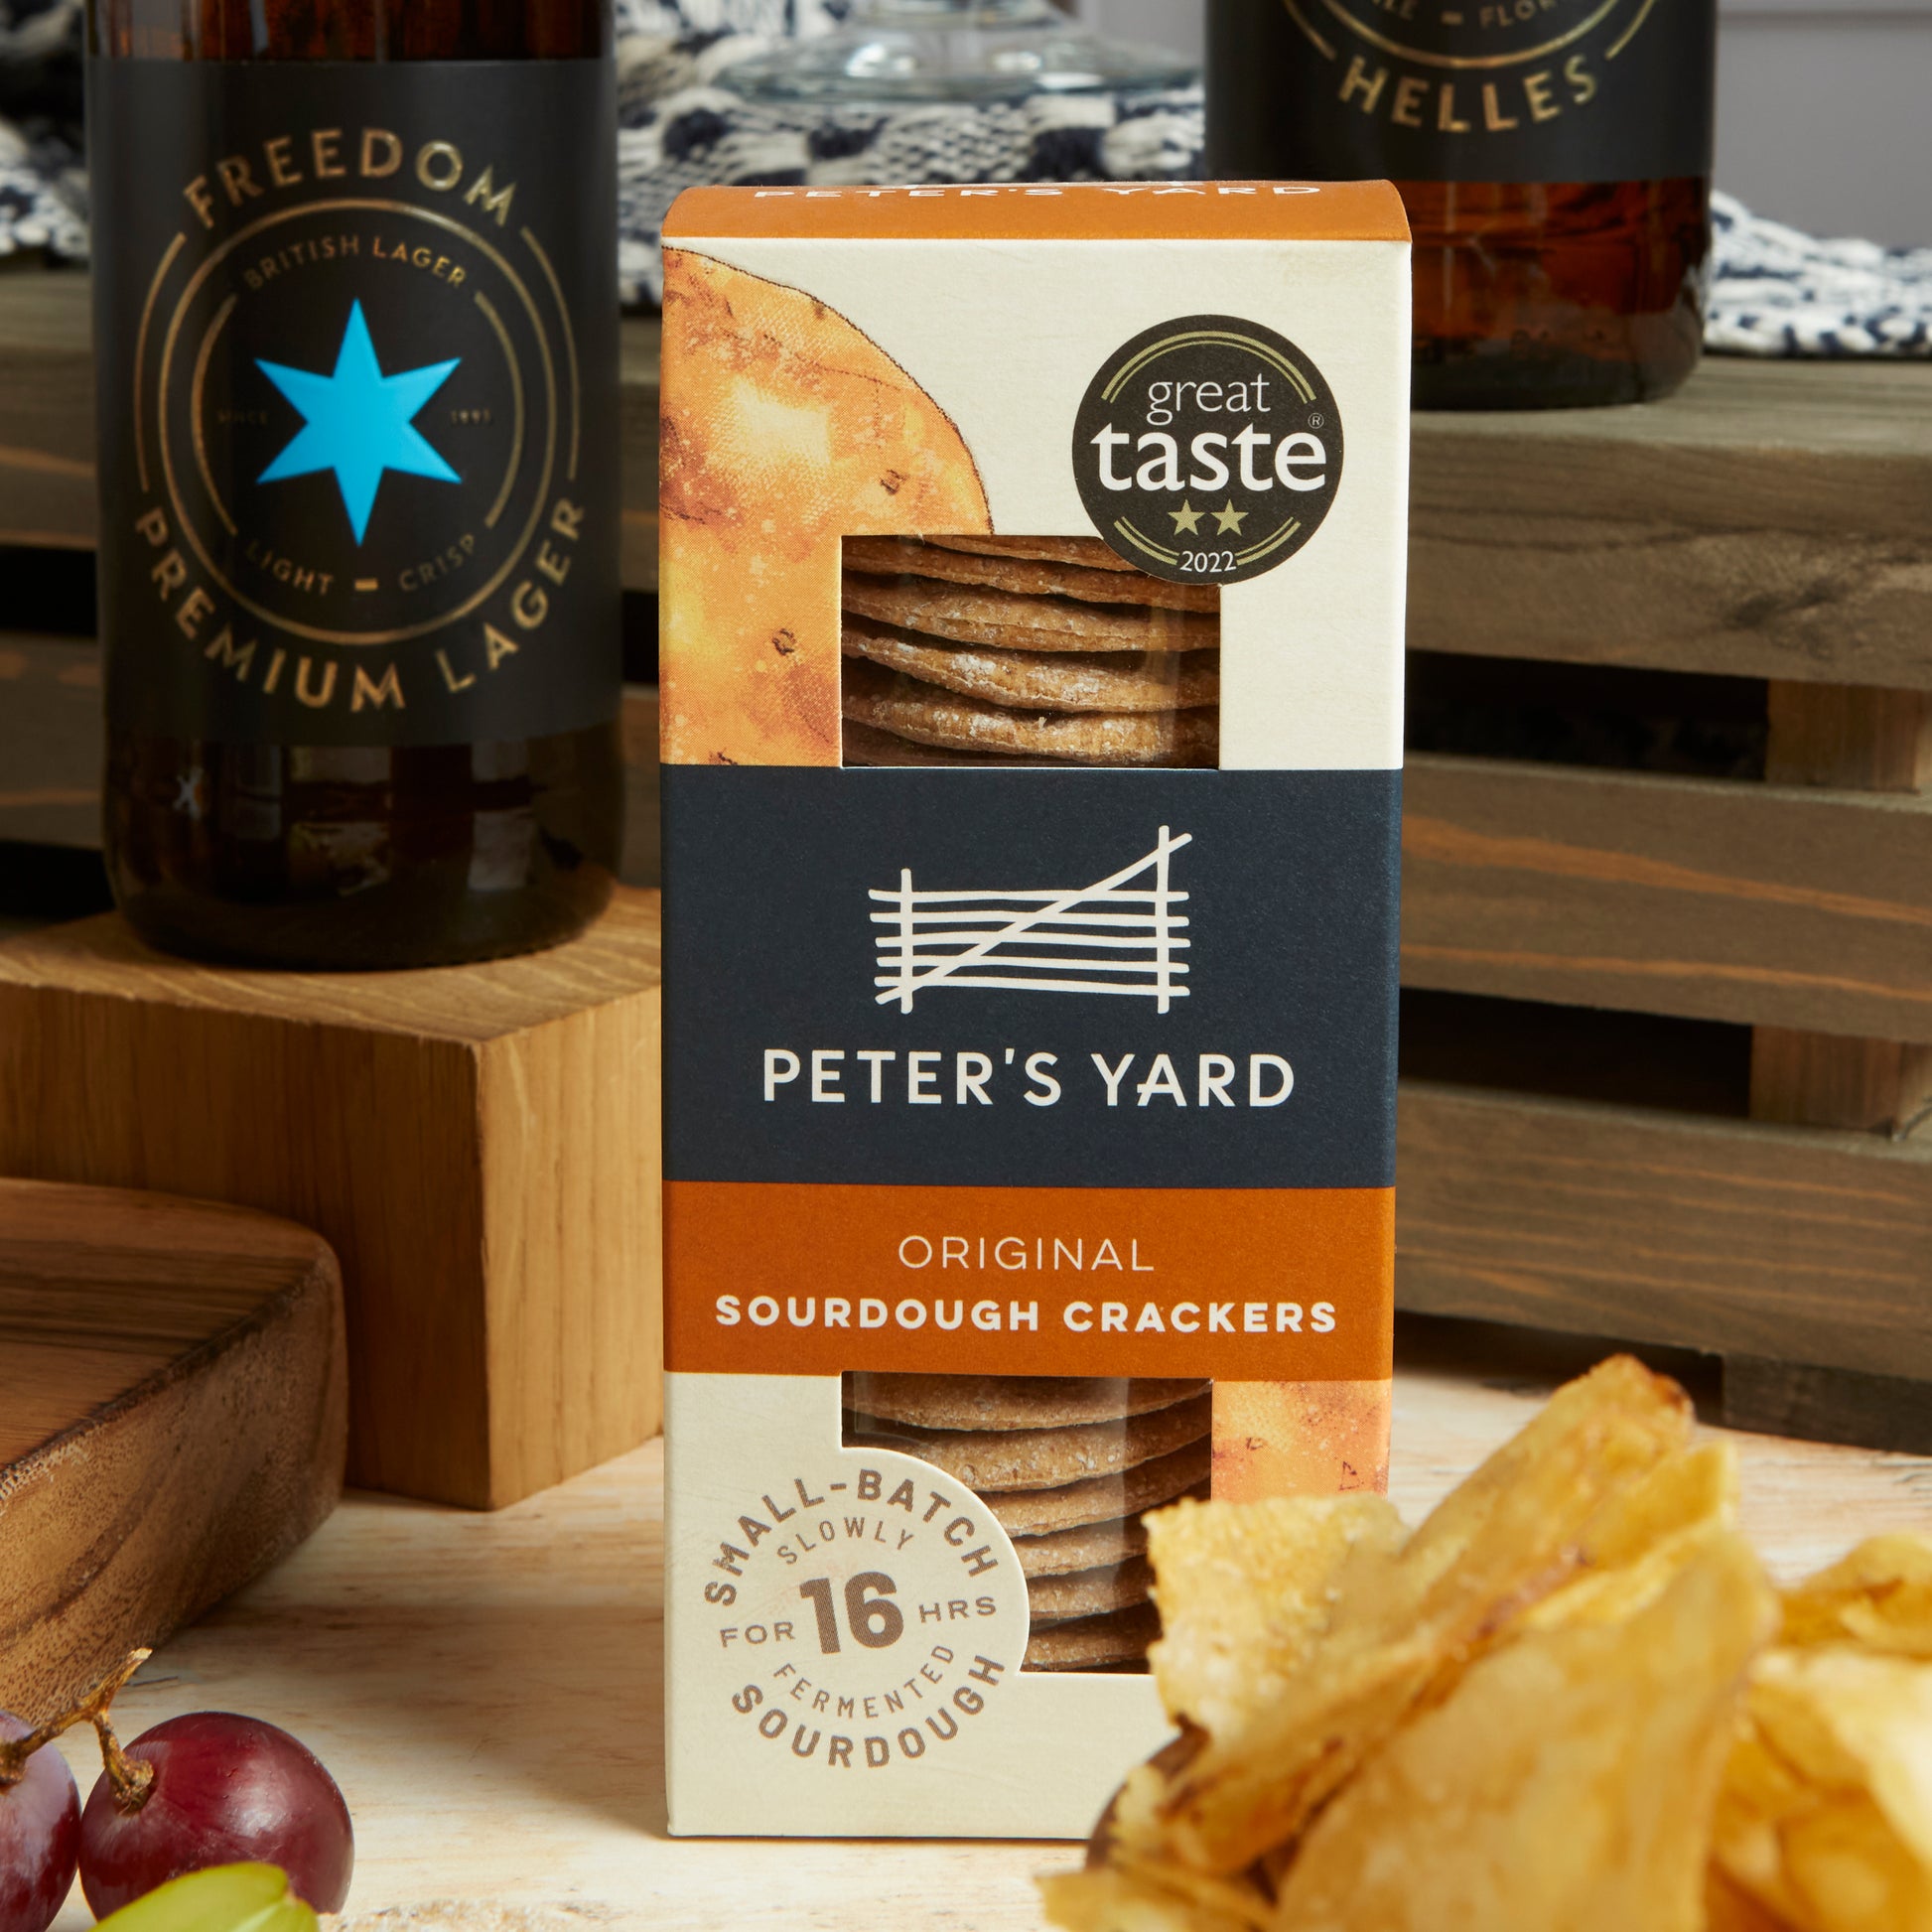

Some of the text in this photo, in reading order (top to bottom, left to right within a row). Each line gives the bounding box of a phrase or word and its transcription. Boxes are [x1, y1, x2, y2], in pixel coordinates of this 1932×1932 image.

[1338, 55, 1597, 132] HELLES
[182, 127, 517, 229] FREEDOM
[755, 188, 1063, 198] PETER'S
[241, 234, 469, 290] BRITISH LAGER
[1146, 372, 1272, 427] great
[1089, 421, 1328, 491] taste
[244, 533, 479, 597] LIGHT CRISP
[1179, 550, 1238, 573] 2022
[134, 496, 586, 713] PREMIUM LAGER
[762, 1047, 1296, 1108] PETER'S YARD
[897, 1234, 1155, 1273] ORIGINAL
[716, 1295, 1337, 1334] SOURDOUGH CRACKERS
[704, 1468, 999, 1606] SMALL-BATCH
[776, 1516, 914, 1566] SLOWLY
[720, 1571, 997, 1655] FOR 16 HRS
[731, 1654, 1006, 1769] SOURDOUGH
[772, 1644, 955, 1720] FERMENTED
